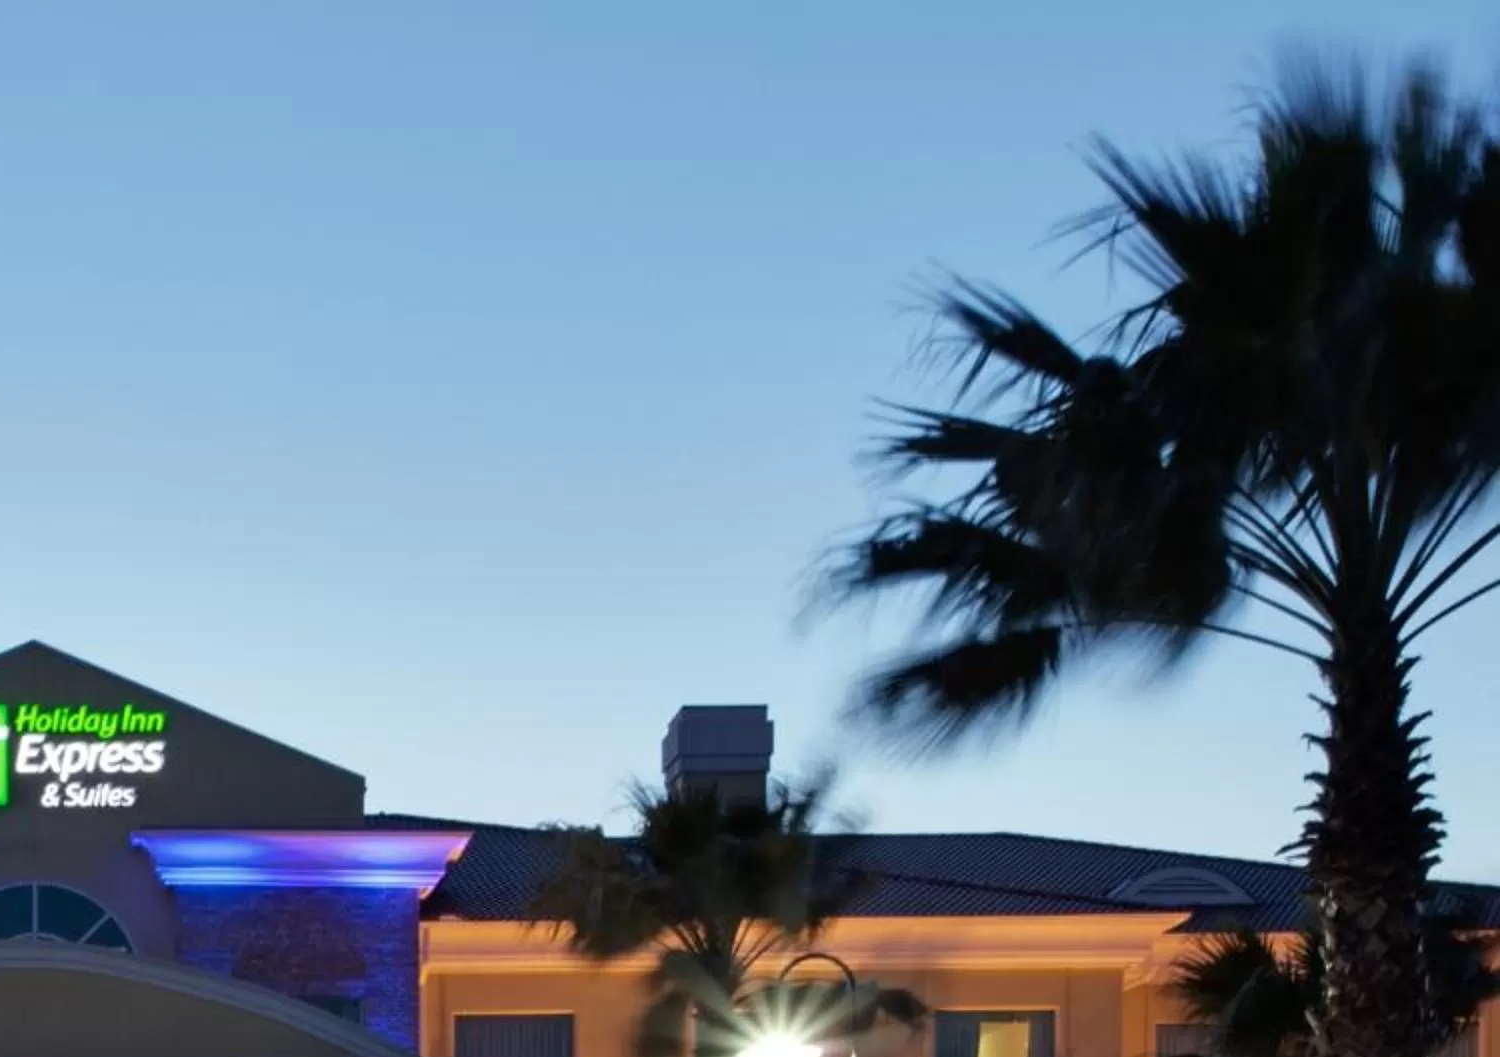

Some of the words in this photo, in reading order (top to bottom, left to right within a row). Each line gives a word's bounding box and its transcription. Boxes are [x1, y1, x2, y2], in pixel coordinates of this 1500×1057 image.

[15, 704, 118, 737] Holiday
[122, 704, 165, 732] Inn
[14, 734, 166, 783] Express
[40, 783, 60, 808] &
[63, 782, 136, 807] Suites
